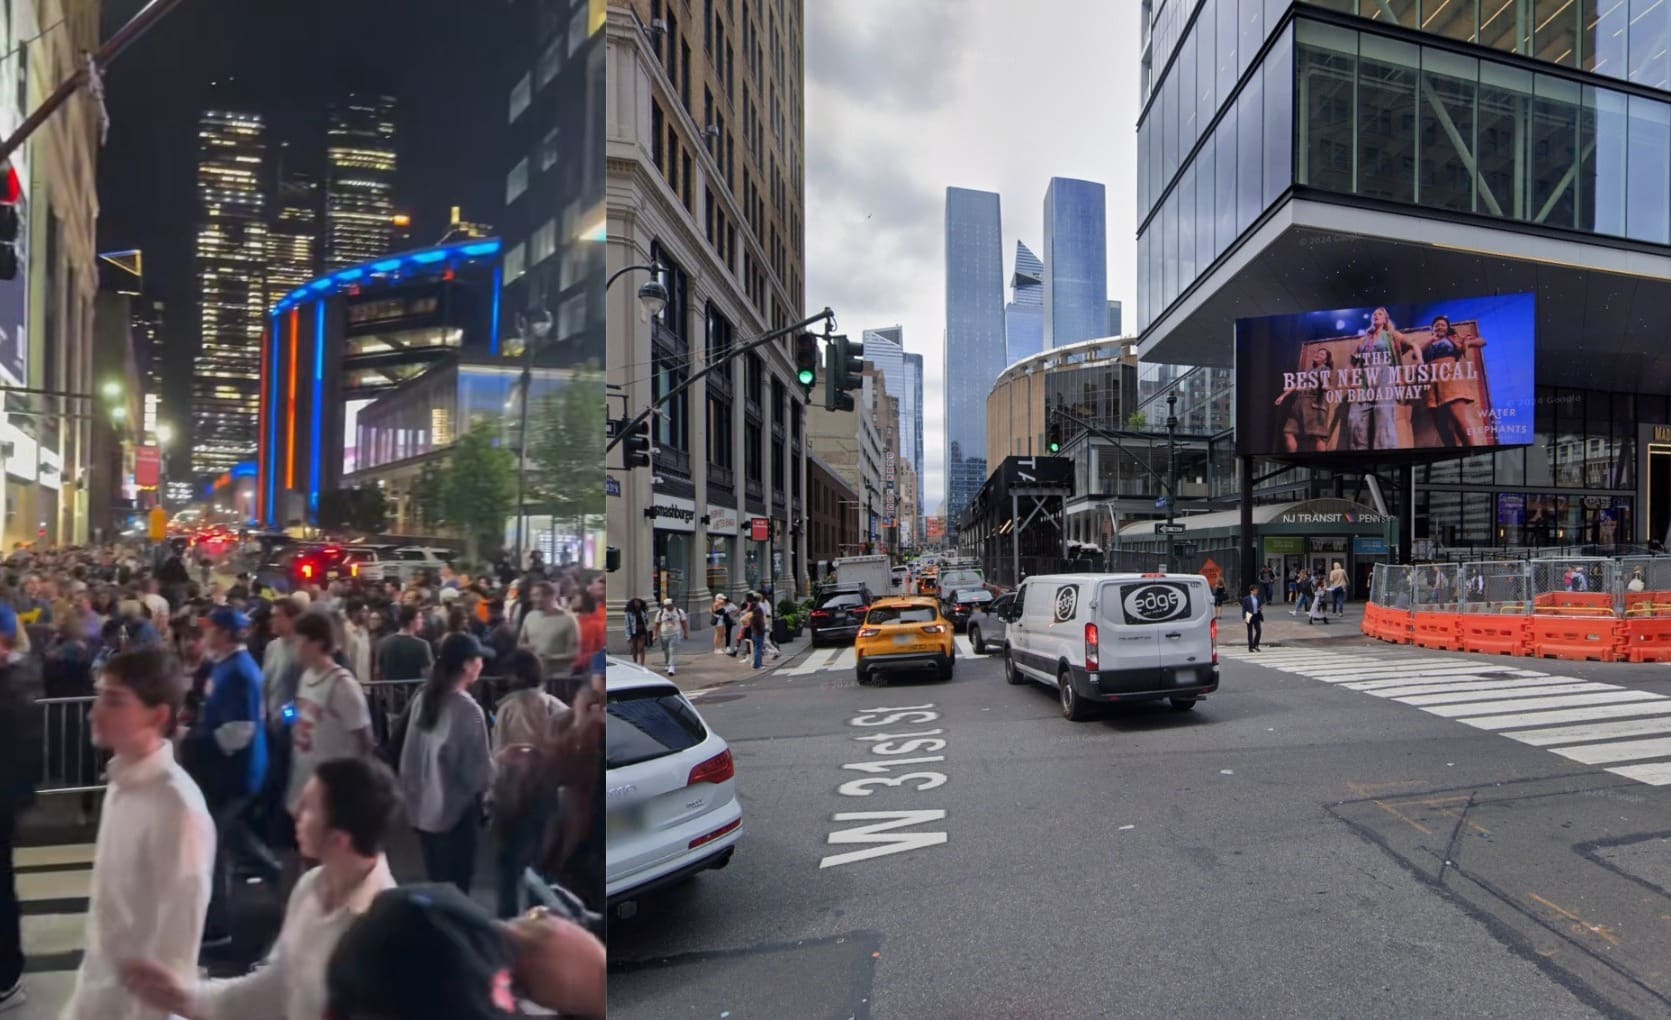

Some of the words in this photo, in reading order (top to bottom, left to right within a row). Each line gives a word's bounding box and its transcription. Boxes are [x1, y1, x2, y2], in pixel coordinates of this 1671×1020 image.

[1283, 369, 1331, 391] BEST
[1337, 366, 1380, 387] NEW
[1388, 361, 1477, 385] MUSICAL
[1326, 389, 1344, 403] ON
[1478, 407, 1516, 420] WATER
[1466, 424, 1527, 436] ELEPHANTS
[1283, 513, 1296, 523] NJ
[1297, 513, 1342, 523] TRANSIT
[1359, 513, 1381, 524] PENN
[1135, 591, 1177, 612] edge
